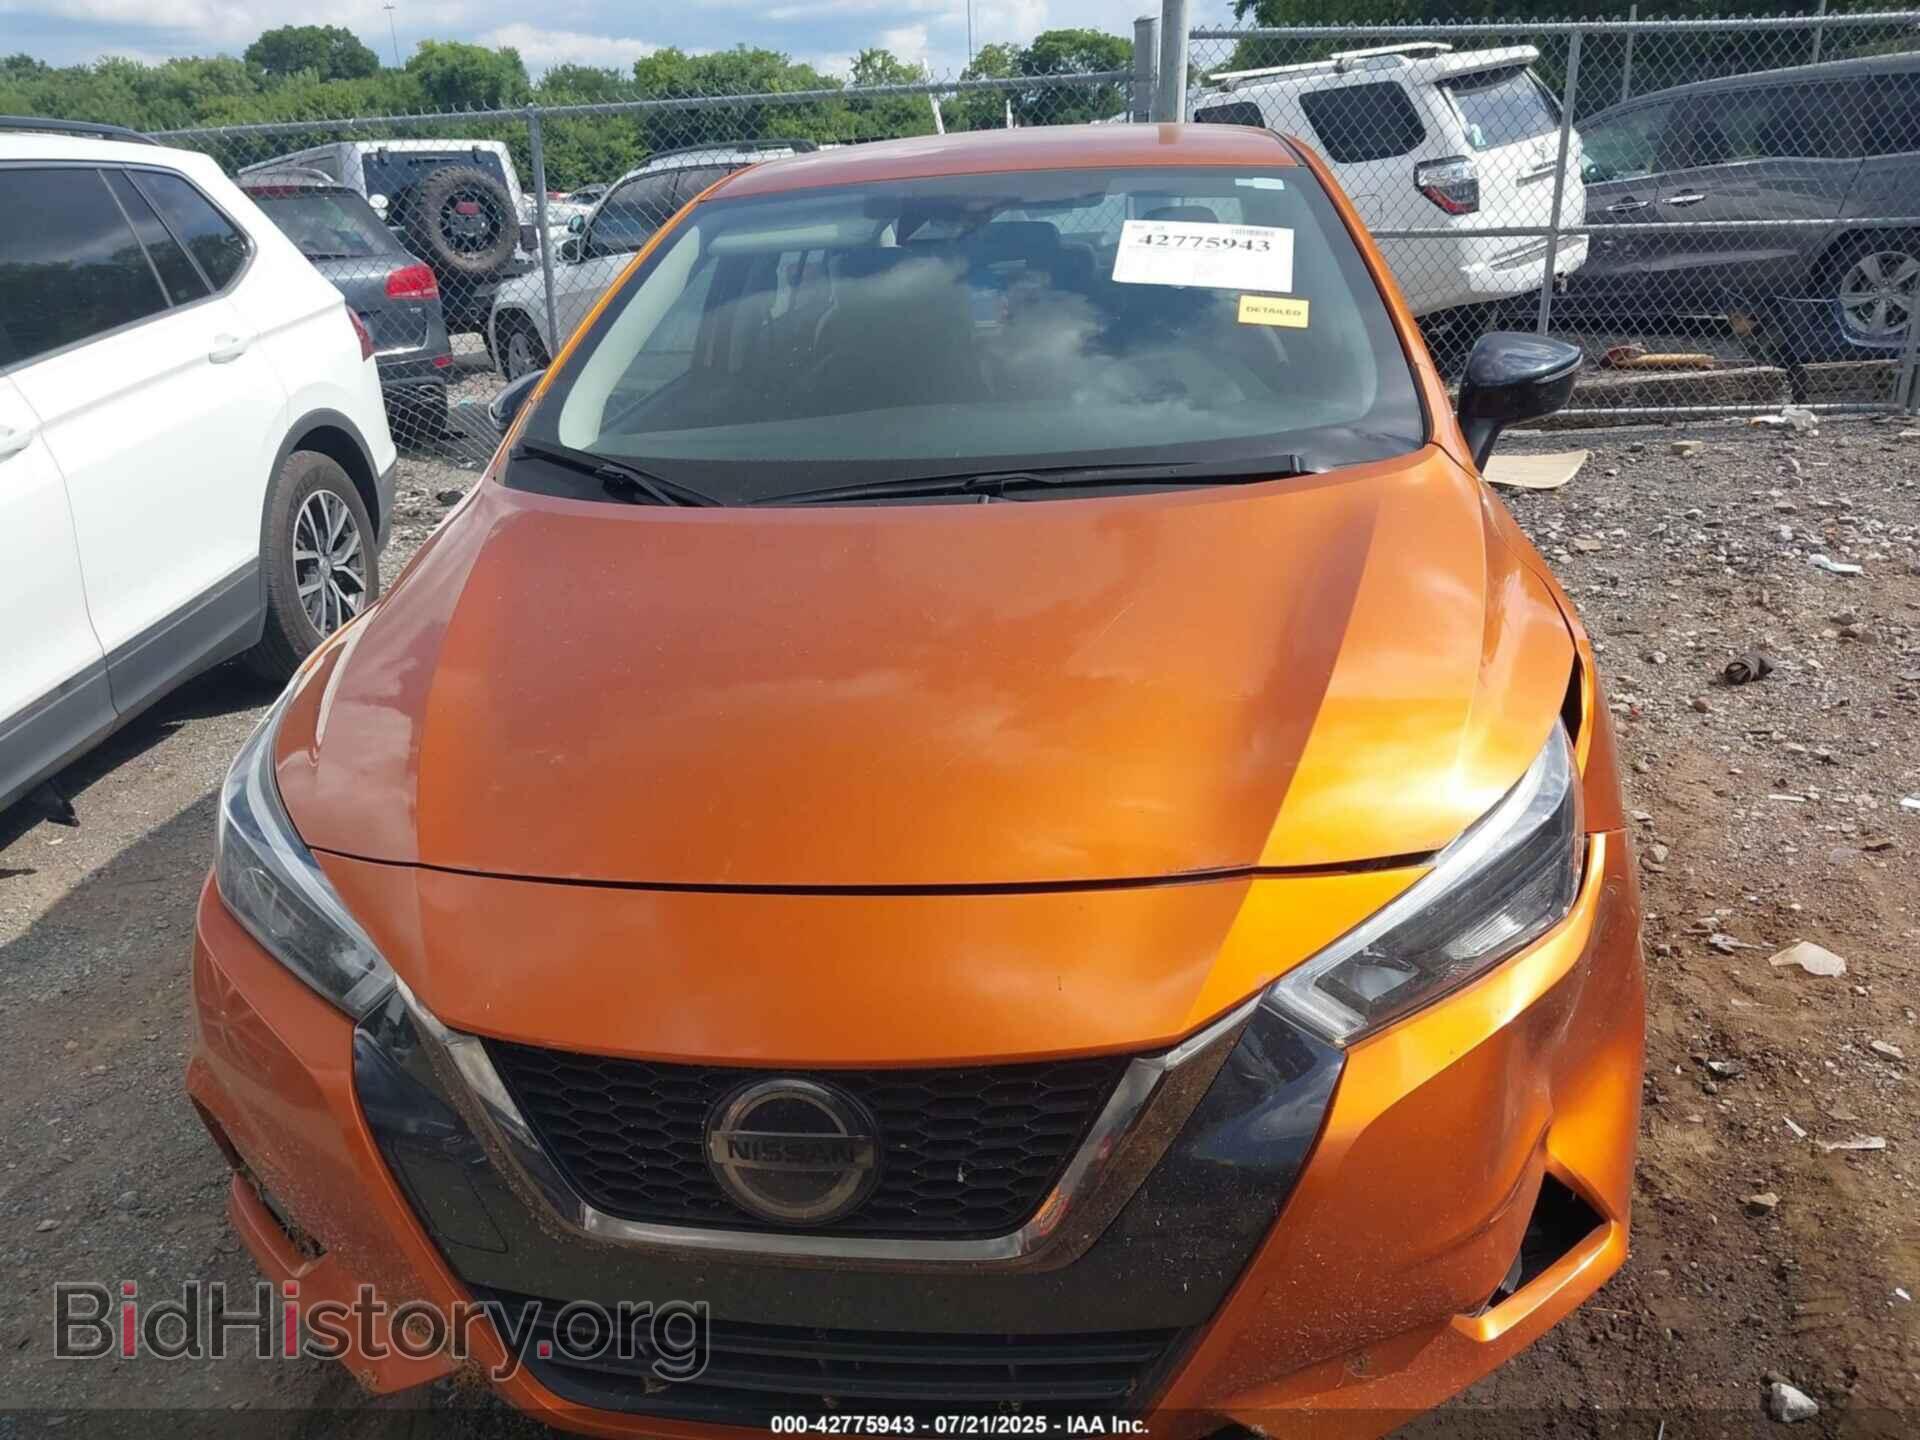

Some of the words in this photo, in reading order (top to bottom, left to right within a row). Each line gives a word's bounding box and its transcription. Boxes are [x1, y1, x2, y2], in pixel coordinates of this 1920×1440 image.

[1137, 233, 1271, 252] 42775943
[1246, 305, 1302, 316] DETAILED
[727, 1140, 856, 1163] NISSAN
